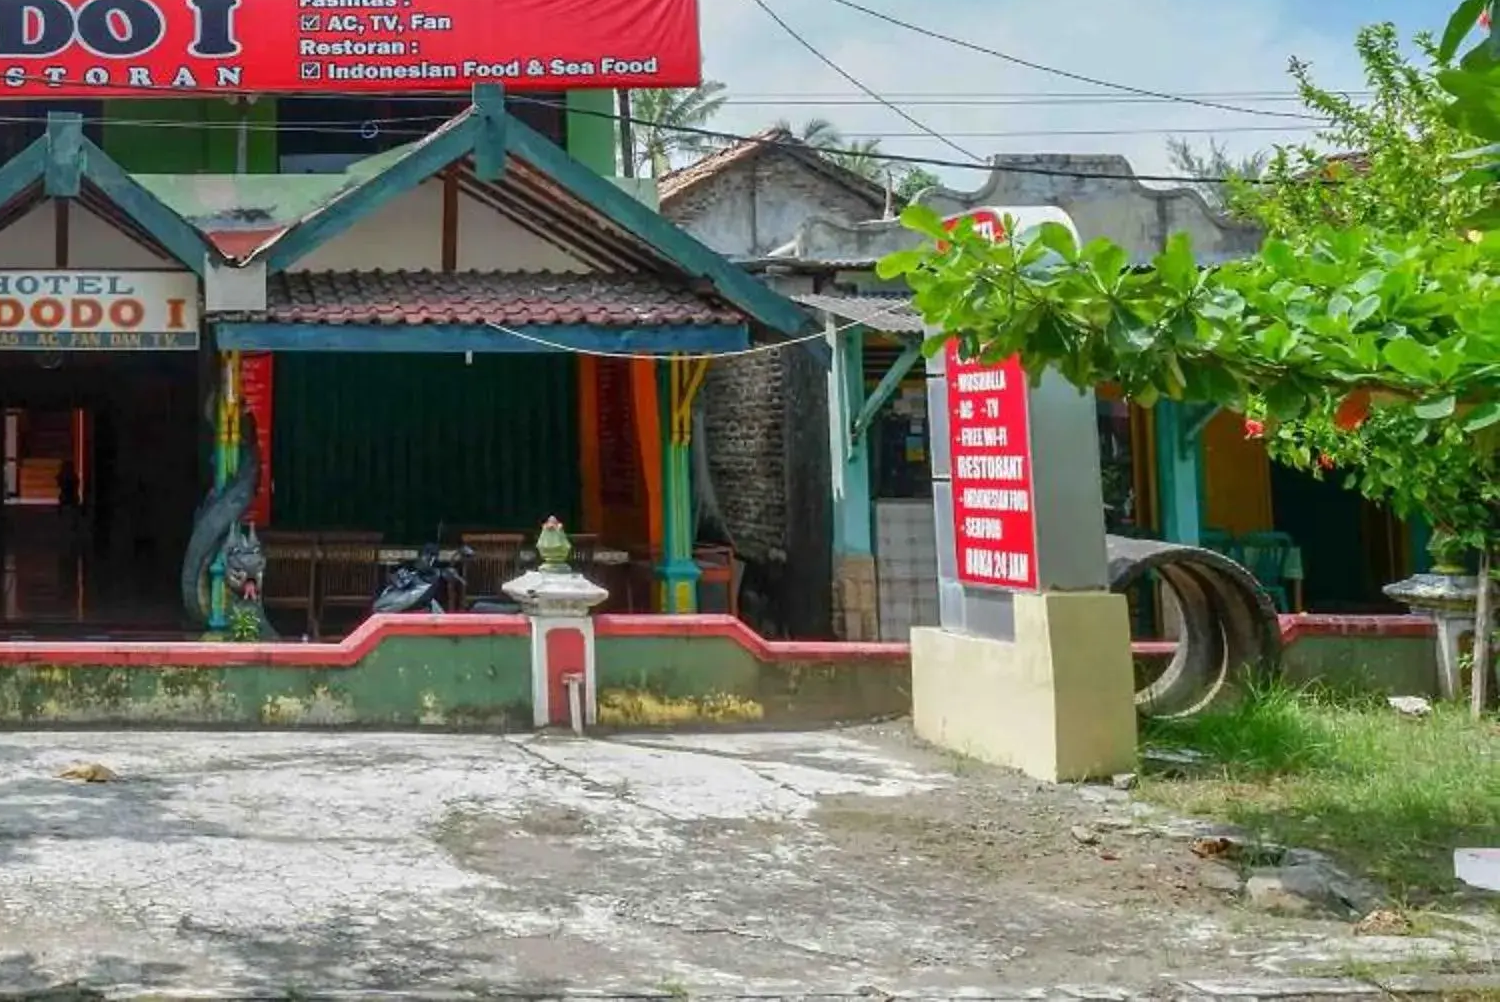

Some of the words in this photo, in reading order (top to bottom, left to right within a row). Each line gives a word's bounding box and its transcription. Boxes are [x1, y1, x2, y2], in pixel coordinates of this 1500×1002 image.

[327, 16, 365, 34] AC,
[370, 15, 404, 34] TV,
[411, 14, 452, 30] Fan
[299, 39, 405, 55] Restoran
[327, 61, 457, 79] Indonesian
[463, 60, 520, 77] Food
[526, 59, 545, 75] &
[550, 58, 595, 76] Sea
[601, 56, 658, 74] Food
[166, 298, 187, 329] I
